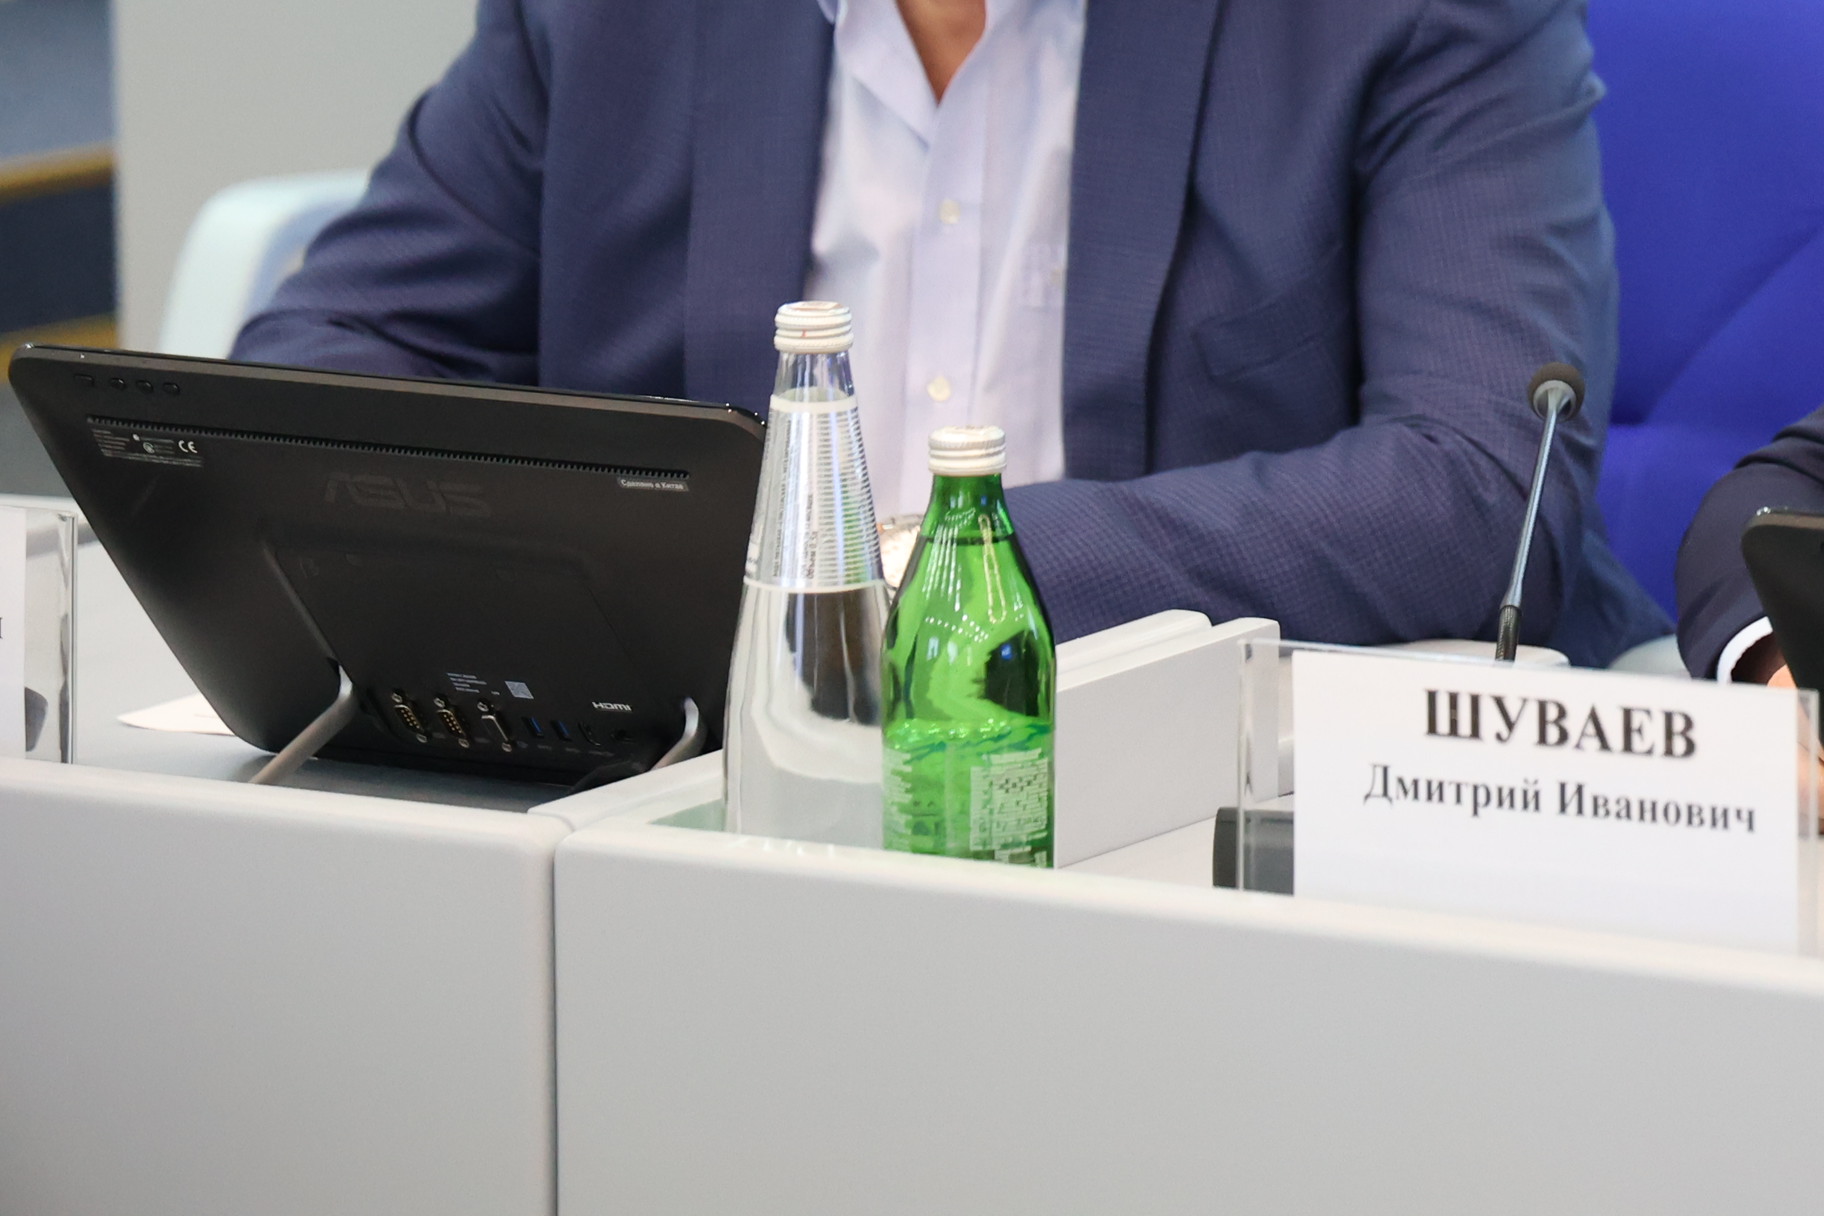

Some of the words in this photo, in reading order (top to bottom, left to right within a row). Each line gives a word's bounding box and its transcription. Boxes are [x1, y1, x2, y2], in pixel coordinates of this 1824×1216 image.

[323, 471, 493, 518] ASUS
[1424, 688, 1698, 760] ШУВАЕВ
[1364, 763, 1541, 818] Дмитрий
[1556, 782, 1757, 833] Иванович
